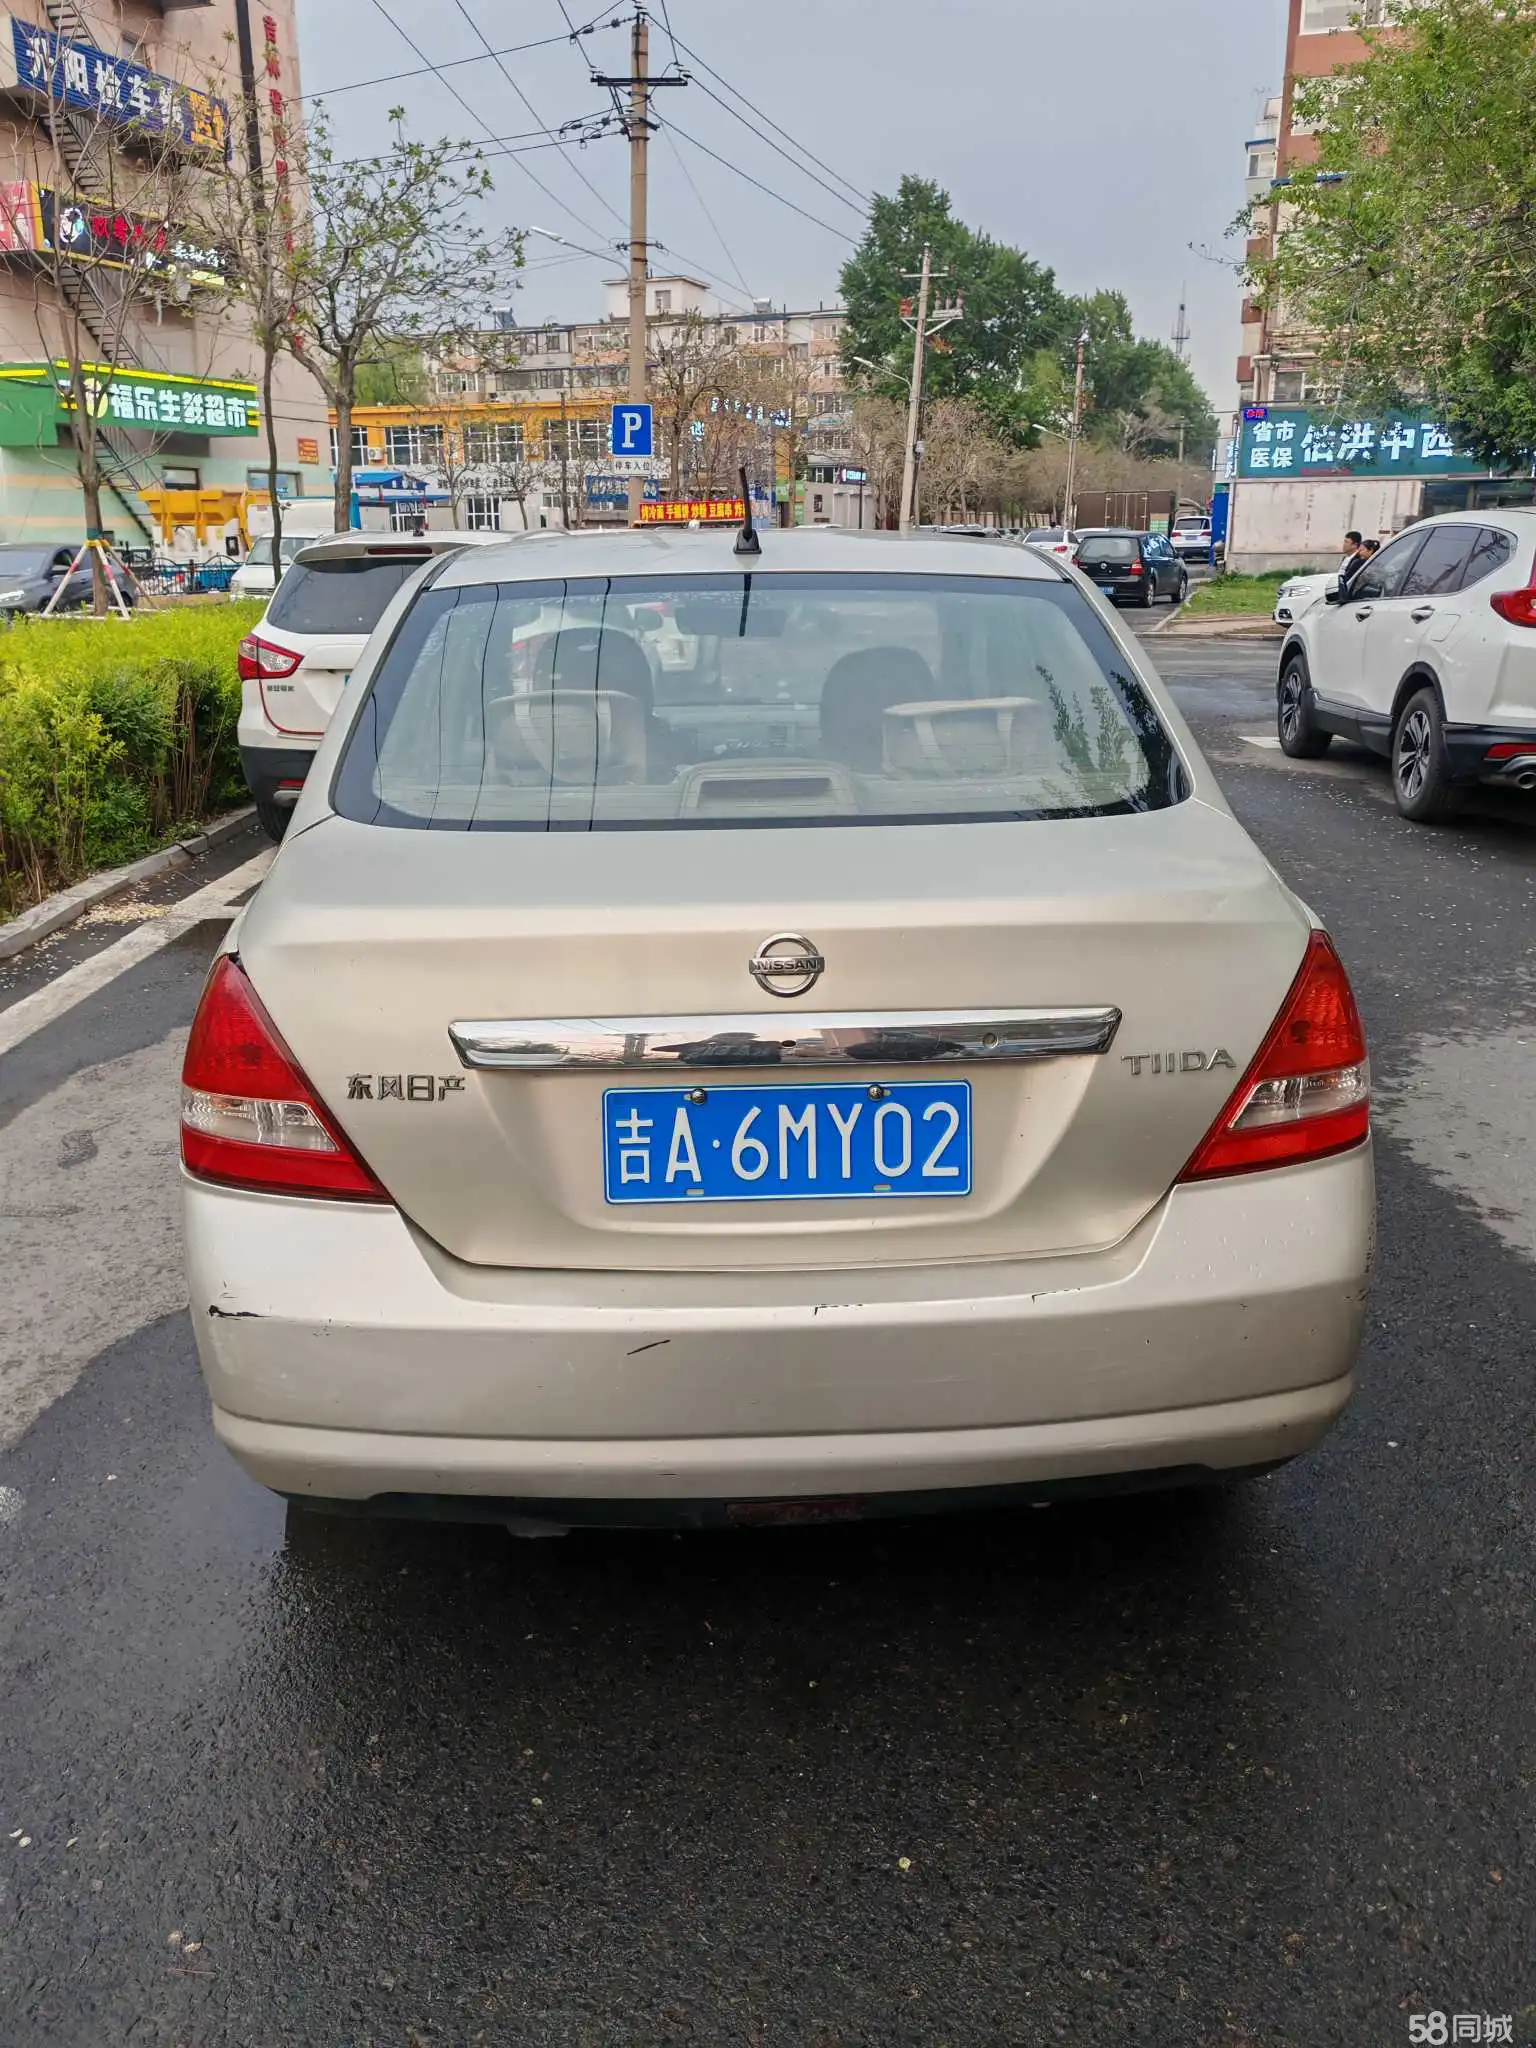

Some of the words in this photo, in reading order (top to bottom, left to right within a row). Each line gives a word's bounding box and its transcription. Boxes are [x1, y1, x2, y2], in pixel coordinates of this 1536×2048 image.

[109, 383, 246, 428] 福乐生鲜超市
[622, 412, 642, 448] P
[1252, 420, 1296, 442] 省市
[615, 461, 650, 471] 停车入位
[1250, 446, 1293, 468] 医保
[757, 959, 818, 971] NISSAN
[1120, 1048, 1237, 1075] TIIDA
[346, 1073, 466, 1102] 东风日产
